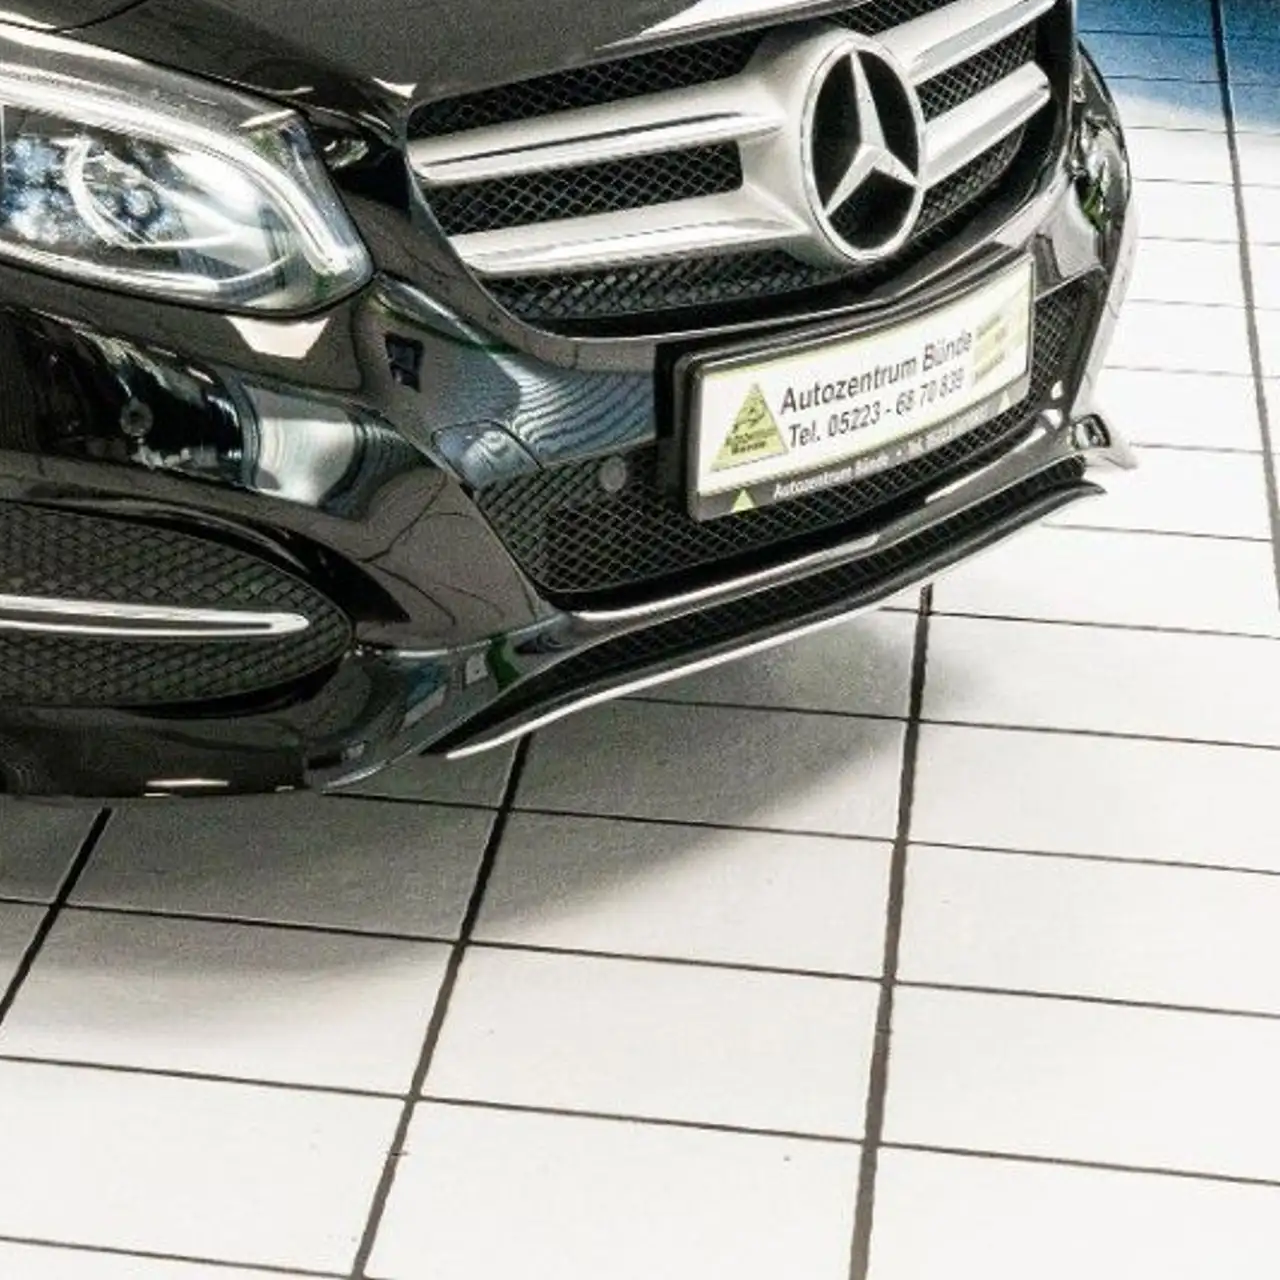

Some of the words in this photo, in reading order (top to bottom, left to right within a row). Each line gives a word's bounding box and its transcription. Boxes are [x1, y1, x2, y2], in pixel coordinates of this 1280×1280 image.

[779, 356, 917, 416] Autozentrum
[922, 328, 973, 372] Bünde
[788, 419, 821, 448] Tel.
[828, 400, 881, 437] 05223
